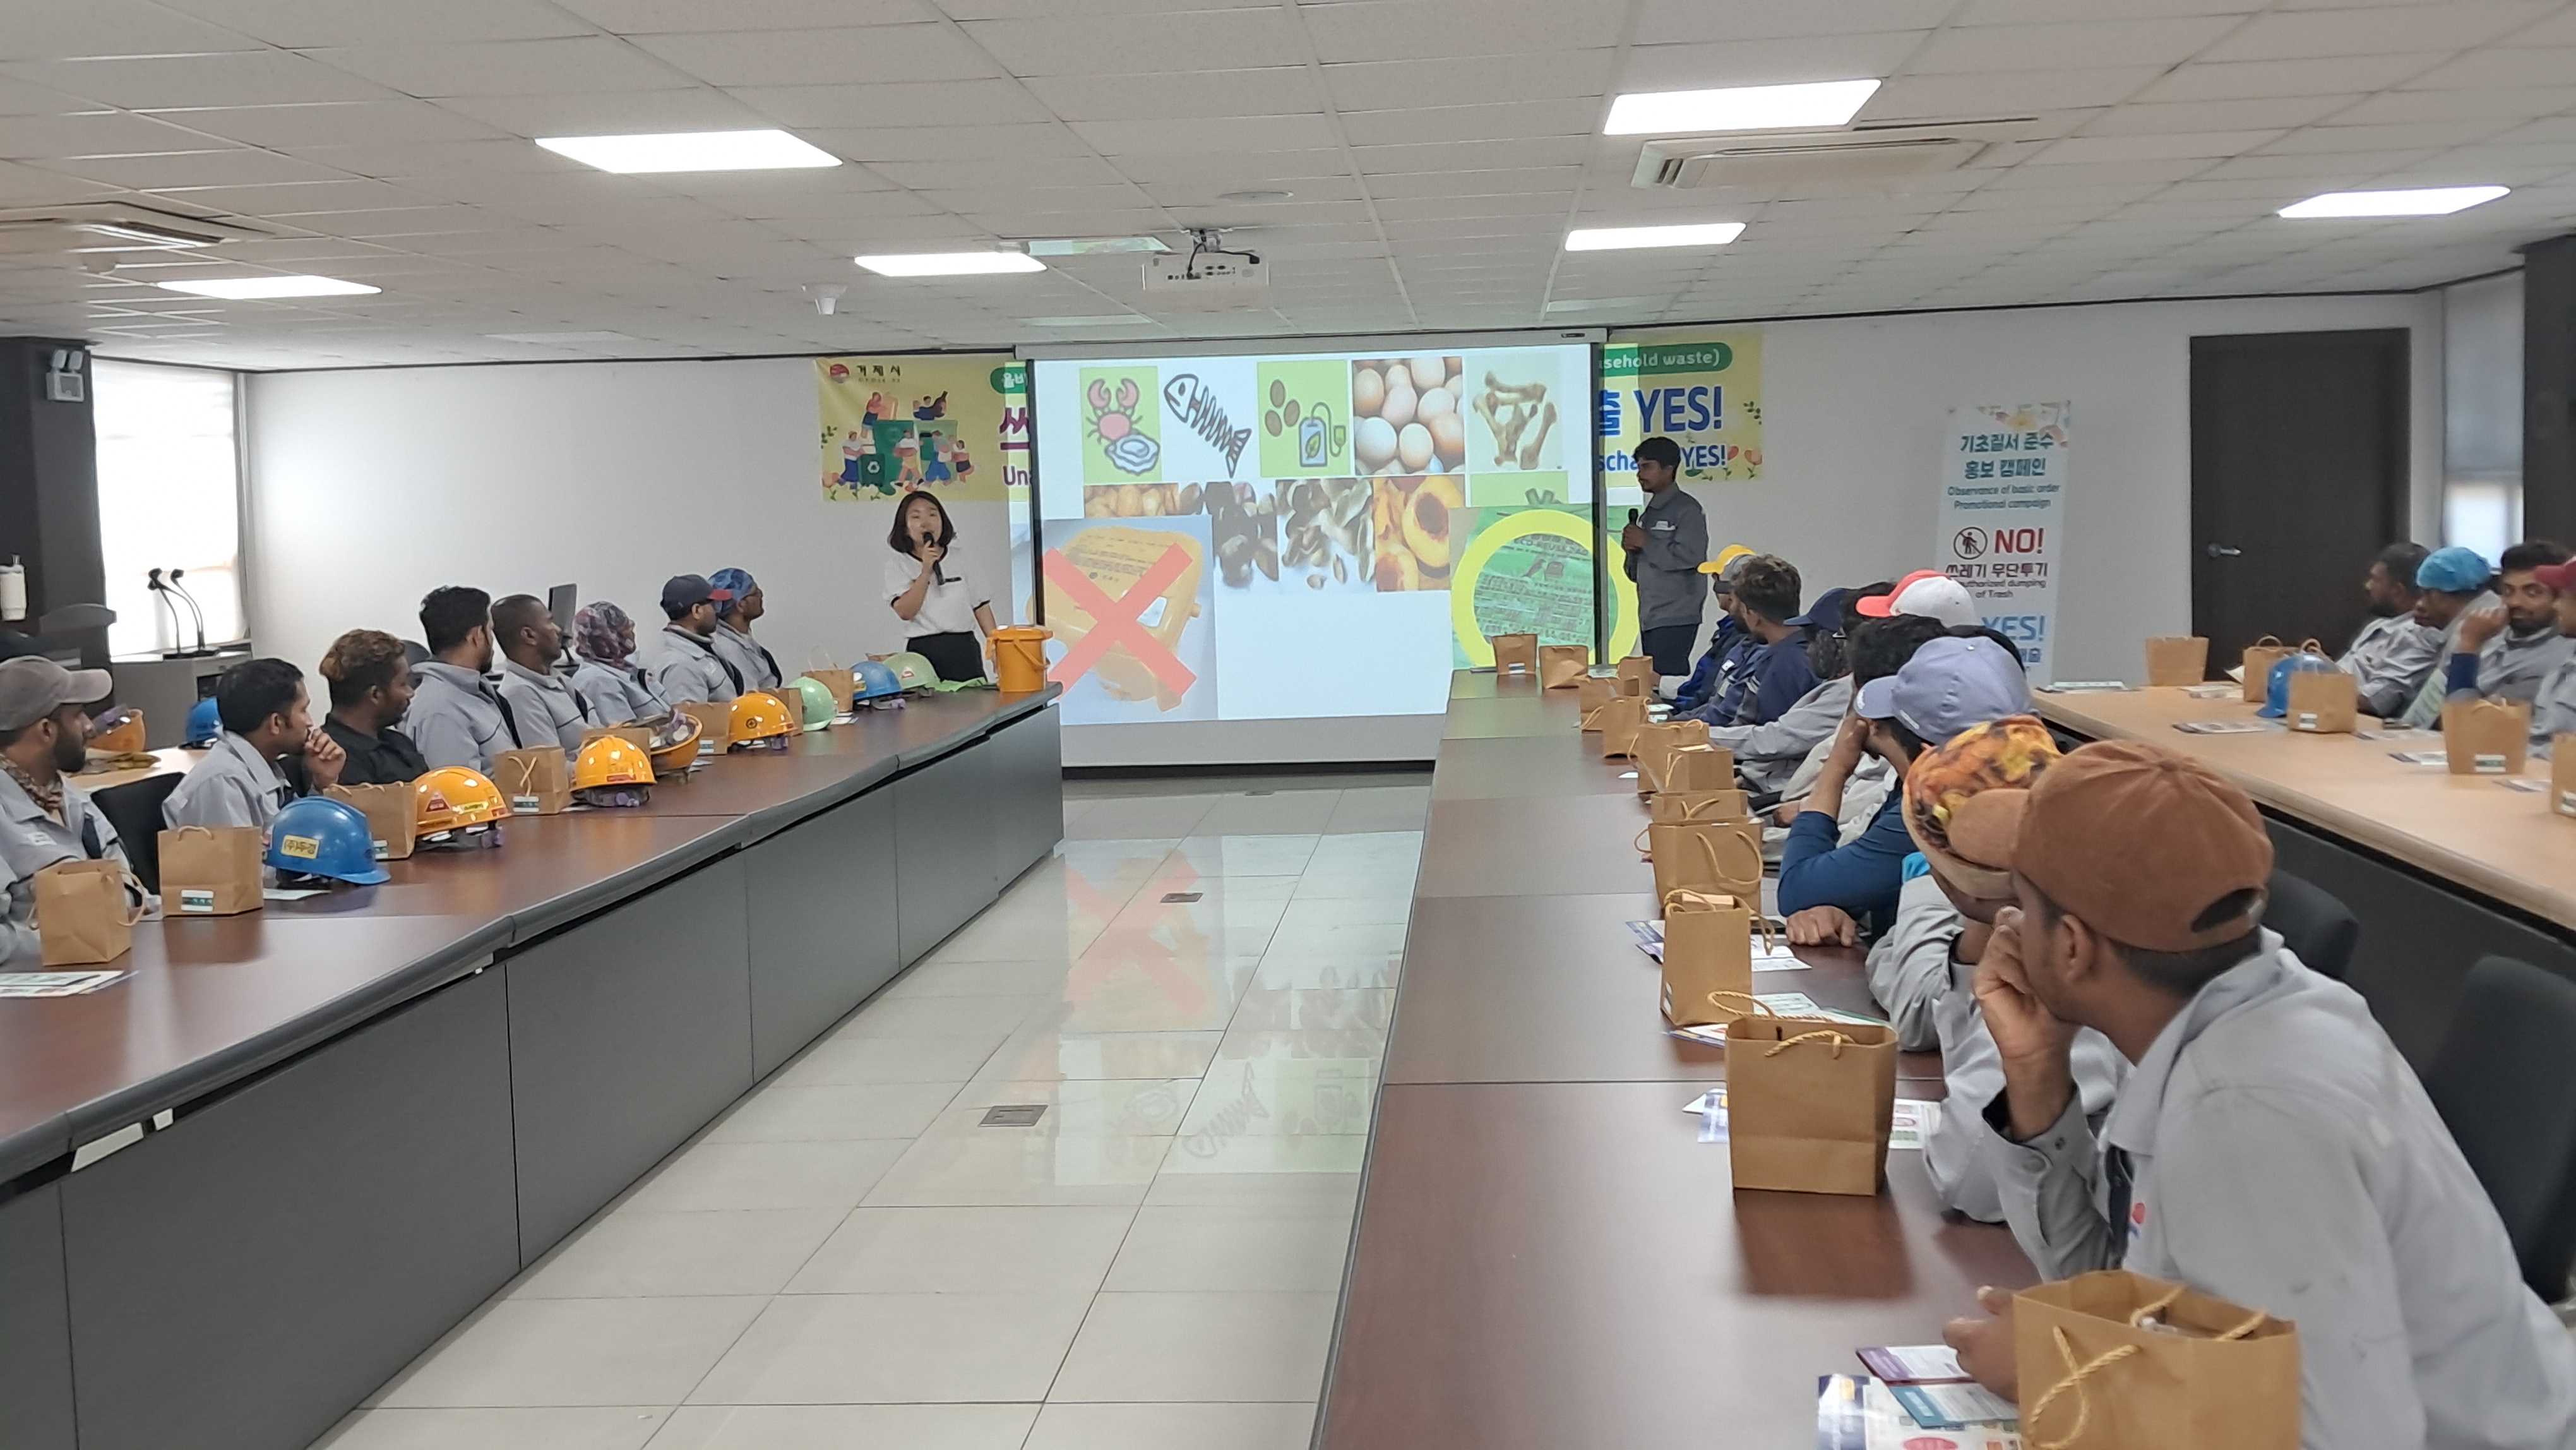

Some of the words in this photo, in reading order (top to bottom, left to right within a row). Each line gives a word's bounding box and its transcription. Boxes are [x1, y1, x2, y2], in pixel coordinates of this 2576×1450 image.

[1599, 352, 1658, 369] sehold
[1662, 348, 1720, 367] waste)
[1633, 386, 1722, 433] YES!
[1960, 433, 2019, 453] 기초질서
[2023, 432, 2054, 450] 준수
[1681, 445, 1726, 468] YES!
[1003, 465, 1029, 486] Un
[1964, 460, 1995, 480] 홍보
[2000, 458, 2046, 477] 캠페인
[1947, 486, 1999, 496] Observance
[2001, 484, 2011, 494] of
[2036, 484, 2060, 493] order
[1994, 527, 2044, 554] NO!
[1945, 564, 1987, 578] 쓰레기
[1991, 563, 2048, 578] 무단투기
[1958, 579, 2005, 588] uthorized
[2007, 578, 2046, 589] dumping
[1975, 590, 1986, 598] of
[1981, 615, 2046, 642] YES!
